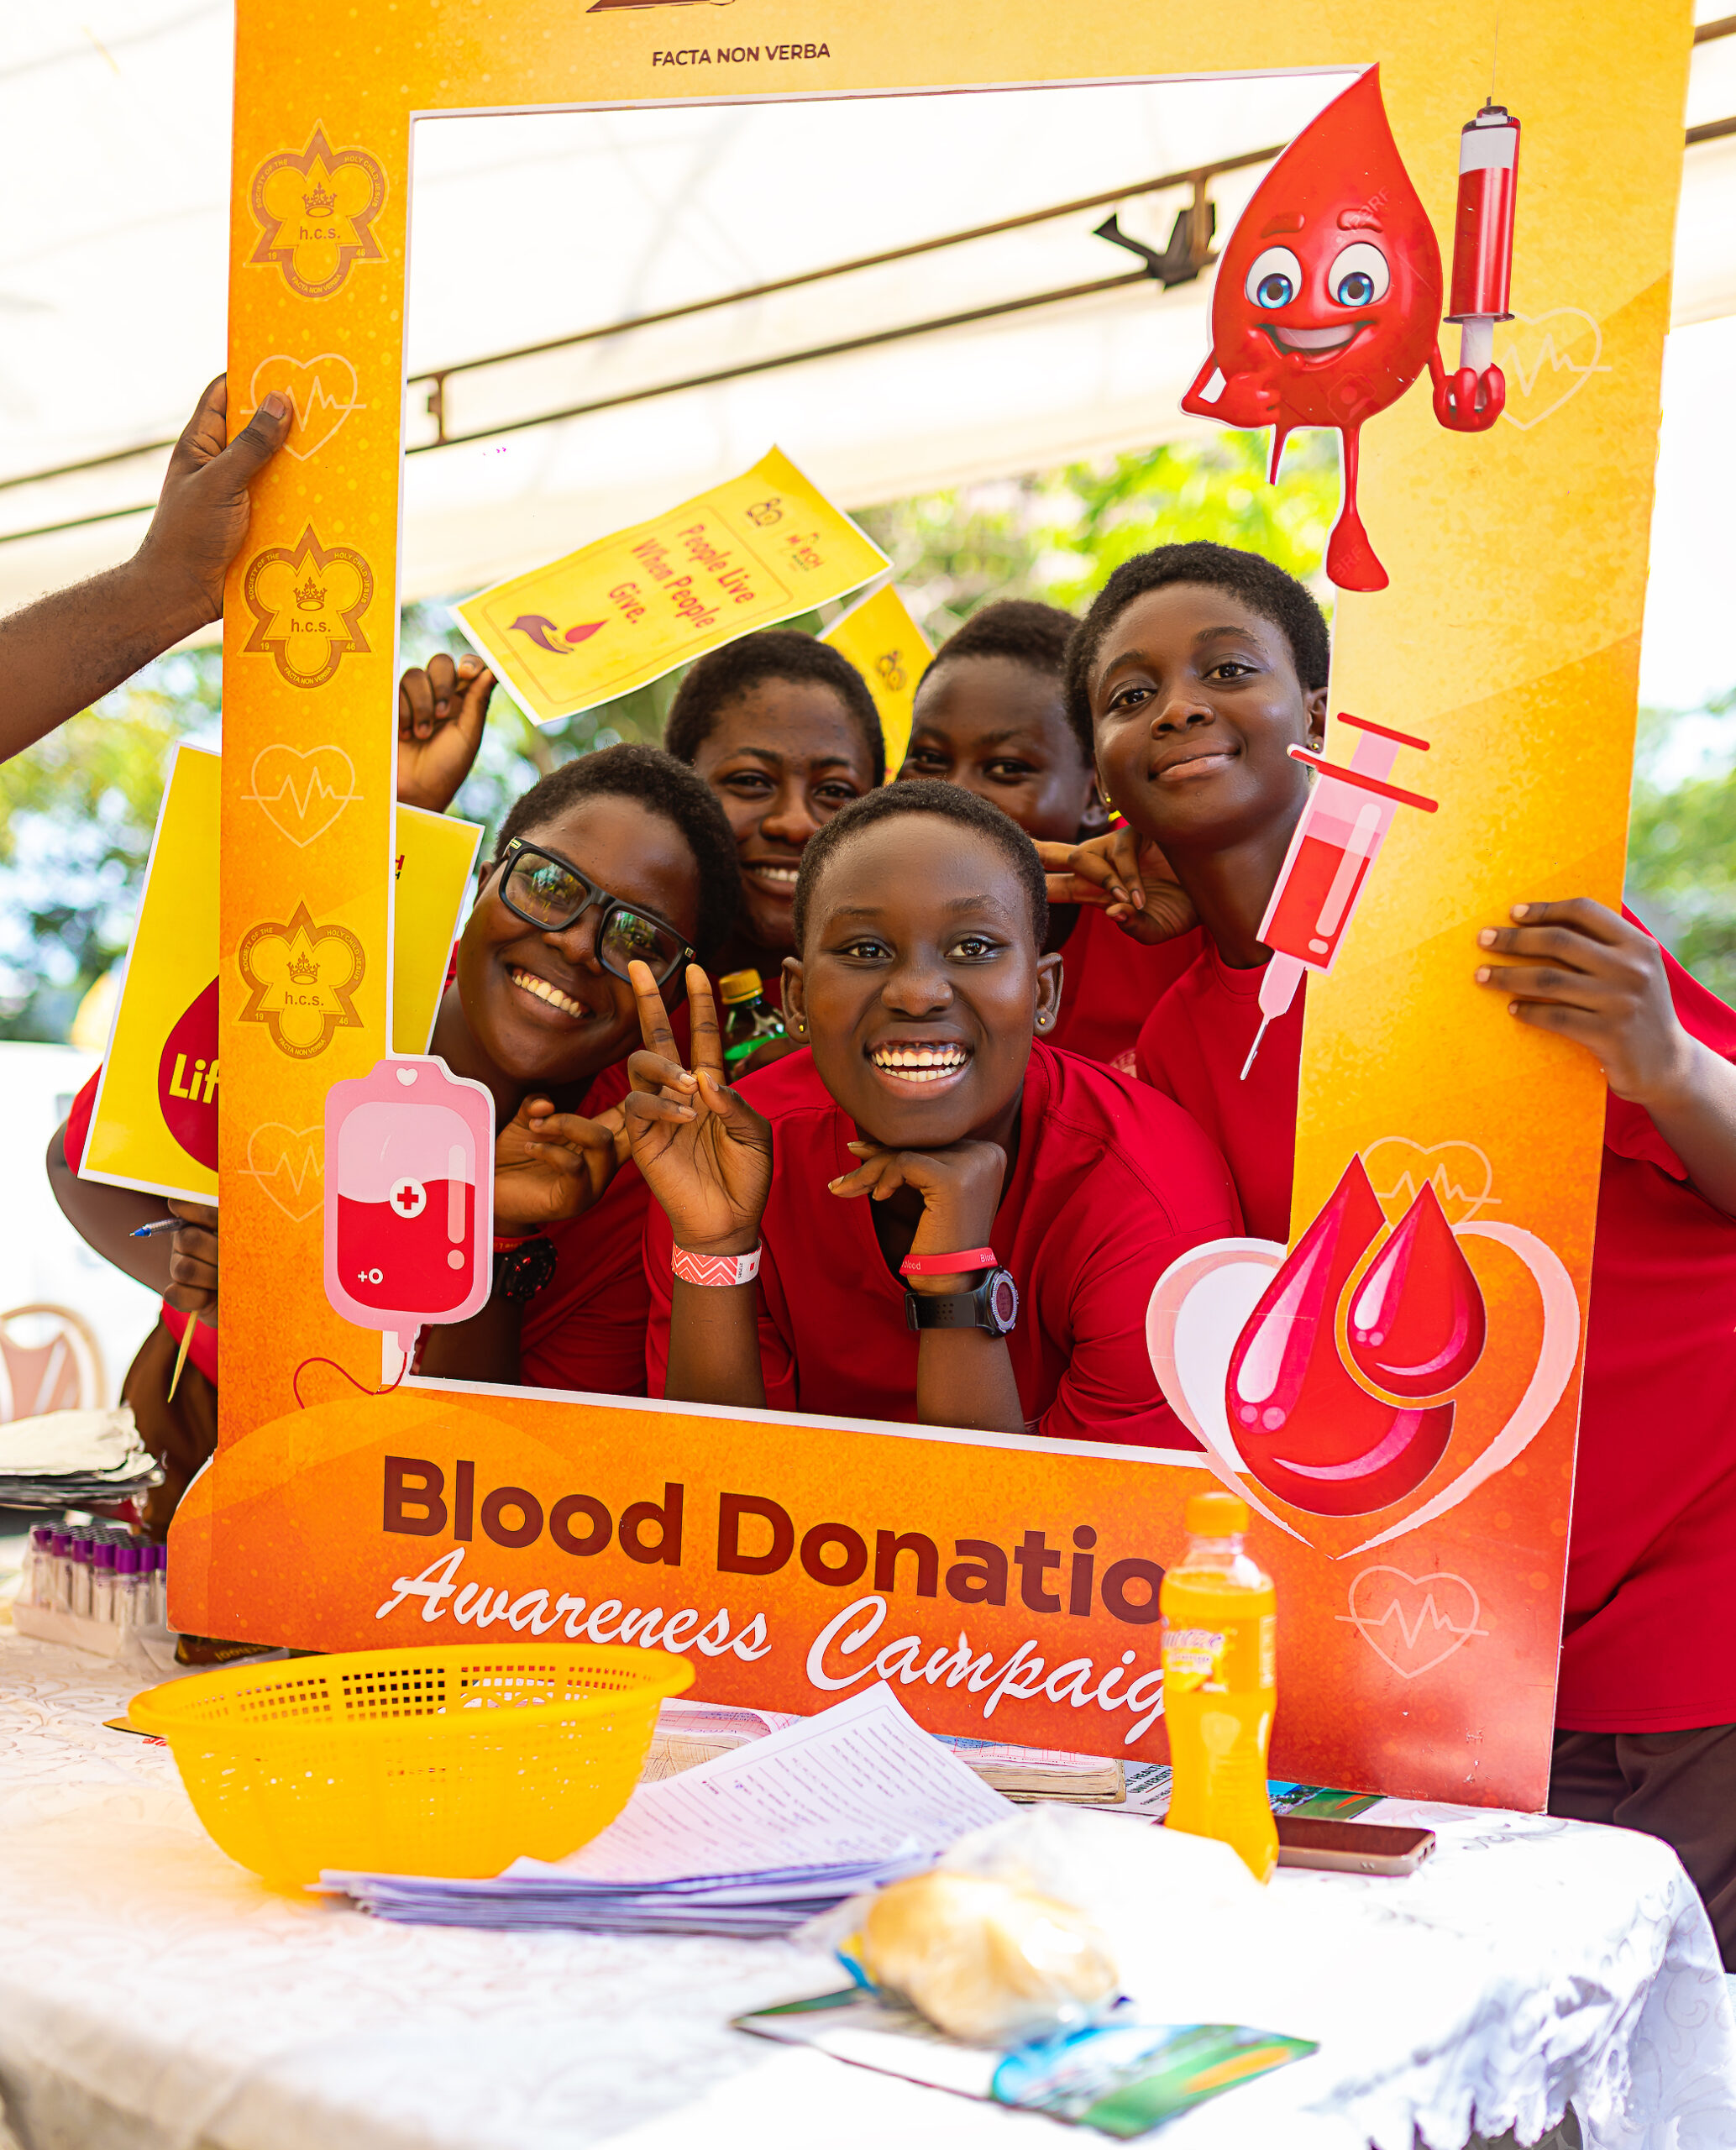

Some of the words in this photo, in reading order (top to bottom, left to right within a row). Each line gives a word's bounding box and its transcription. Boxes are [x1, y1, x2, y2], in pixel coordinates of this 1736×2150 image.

[653, 50, 711, 66] FACTA
[716, 46, 759, 64] NON
[765, 43, 831, 60] VERBA
[299, 226, 341, 240] h.c.s.
[267, 252, 277, 260] 19
[334, 552, 352, 560] HOLY
[353, 557, 368, 578] CHILD
[677, 523, 732, 572] People
[717, 567, 756, 604] Live
[249, 569, 258, 600] SOCIETY
[257, 559, 265, 569] OF
[266, 553, 280, 562] THE
[631, 538, 674, 581] When
[663, 575, 721, 628] People
[360, 579, 370, 604] JESUS
[609, 581, 646, 624] Give.
[291, 618, 331, 632] h.c.s.
[284, 666, 301, 684] FACTA
[314, 666, 333, 683] VERBA
[242, 942, 252, 972] SOCIETY
[251, 933, 260, 941] OF
[327, 930, 345, 938] HOLY
[345, 935, 359, 956] CHILD
[354, 956, 362, 980] JESUS
[285, 991, 324, 1006] h.c.s.
[278, 1037, 295, 1054] FACTA
[307, 1039, 326, 1055] VERBA
[169, 1052, 218, 1104] Lif
[383, 1455, 684, 1566] Blood
[716, 1492, 1165, 1626] Donatio
[375, 1547, 772, 1661] Awareness
[806, 1595, 1166, 1745] Campaig
